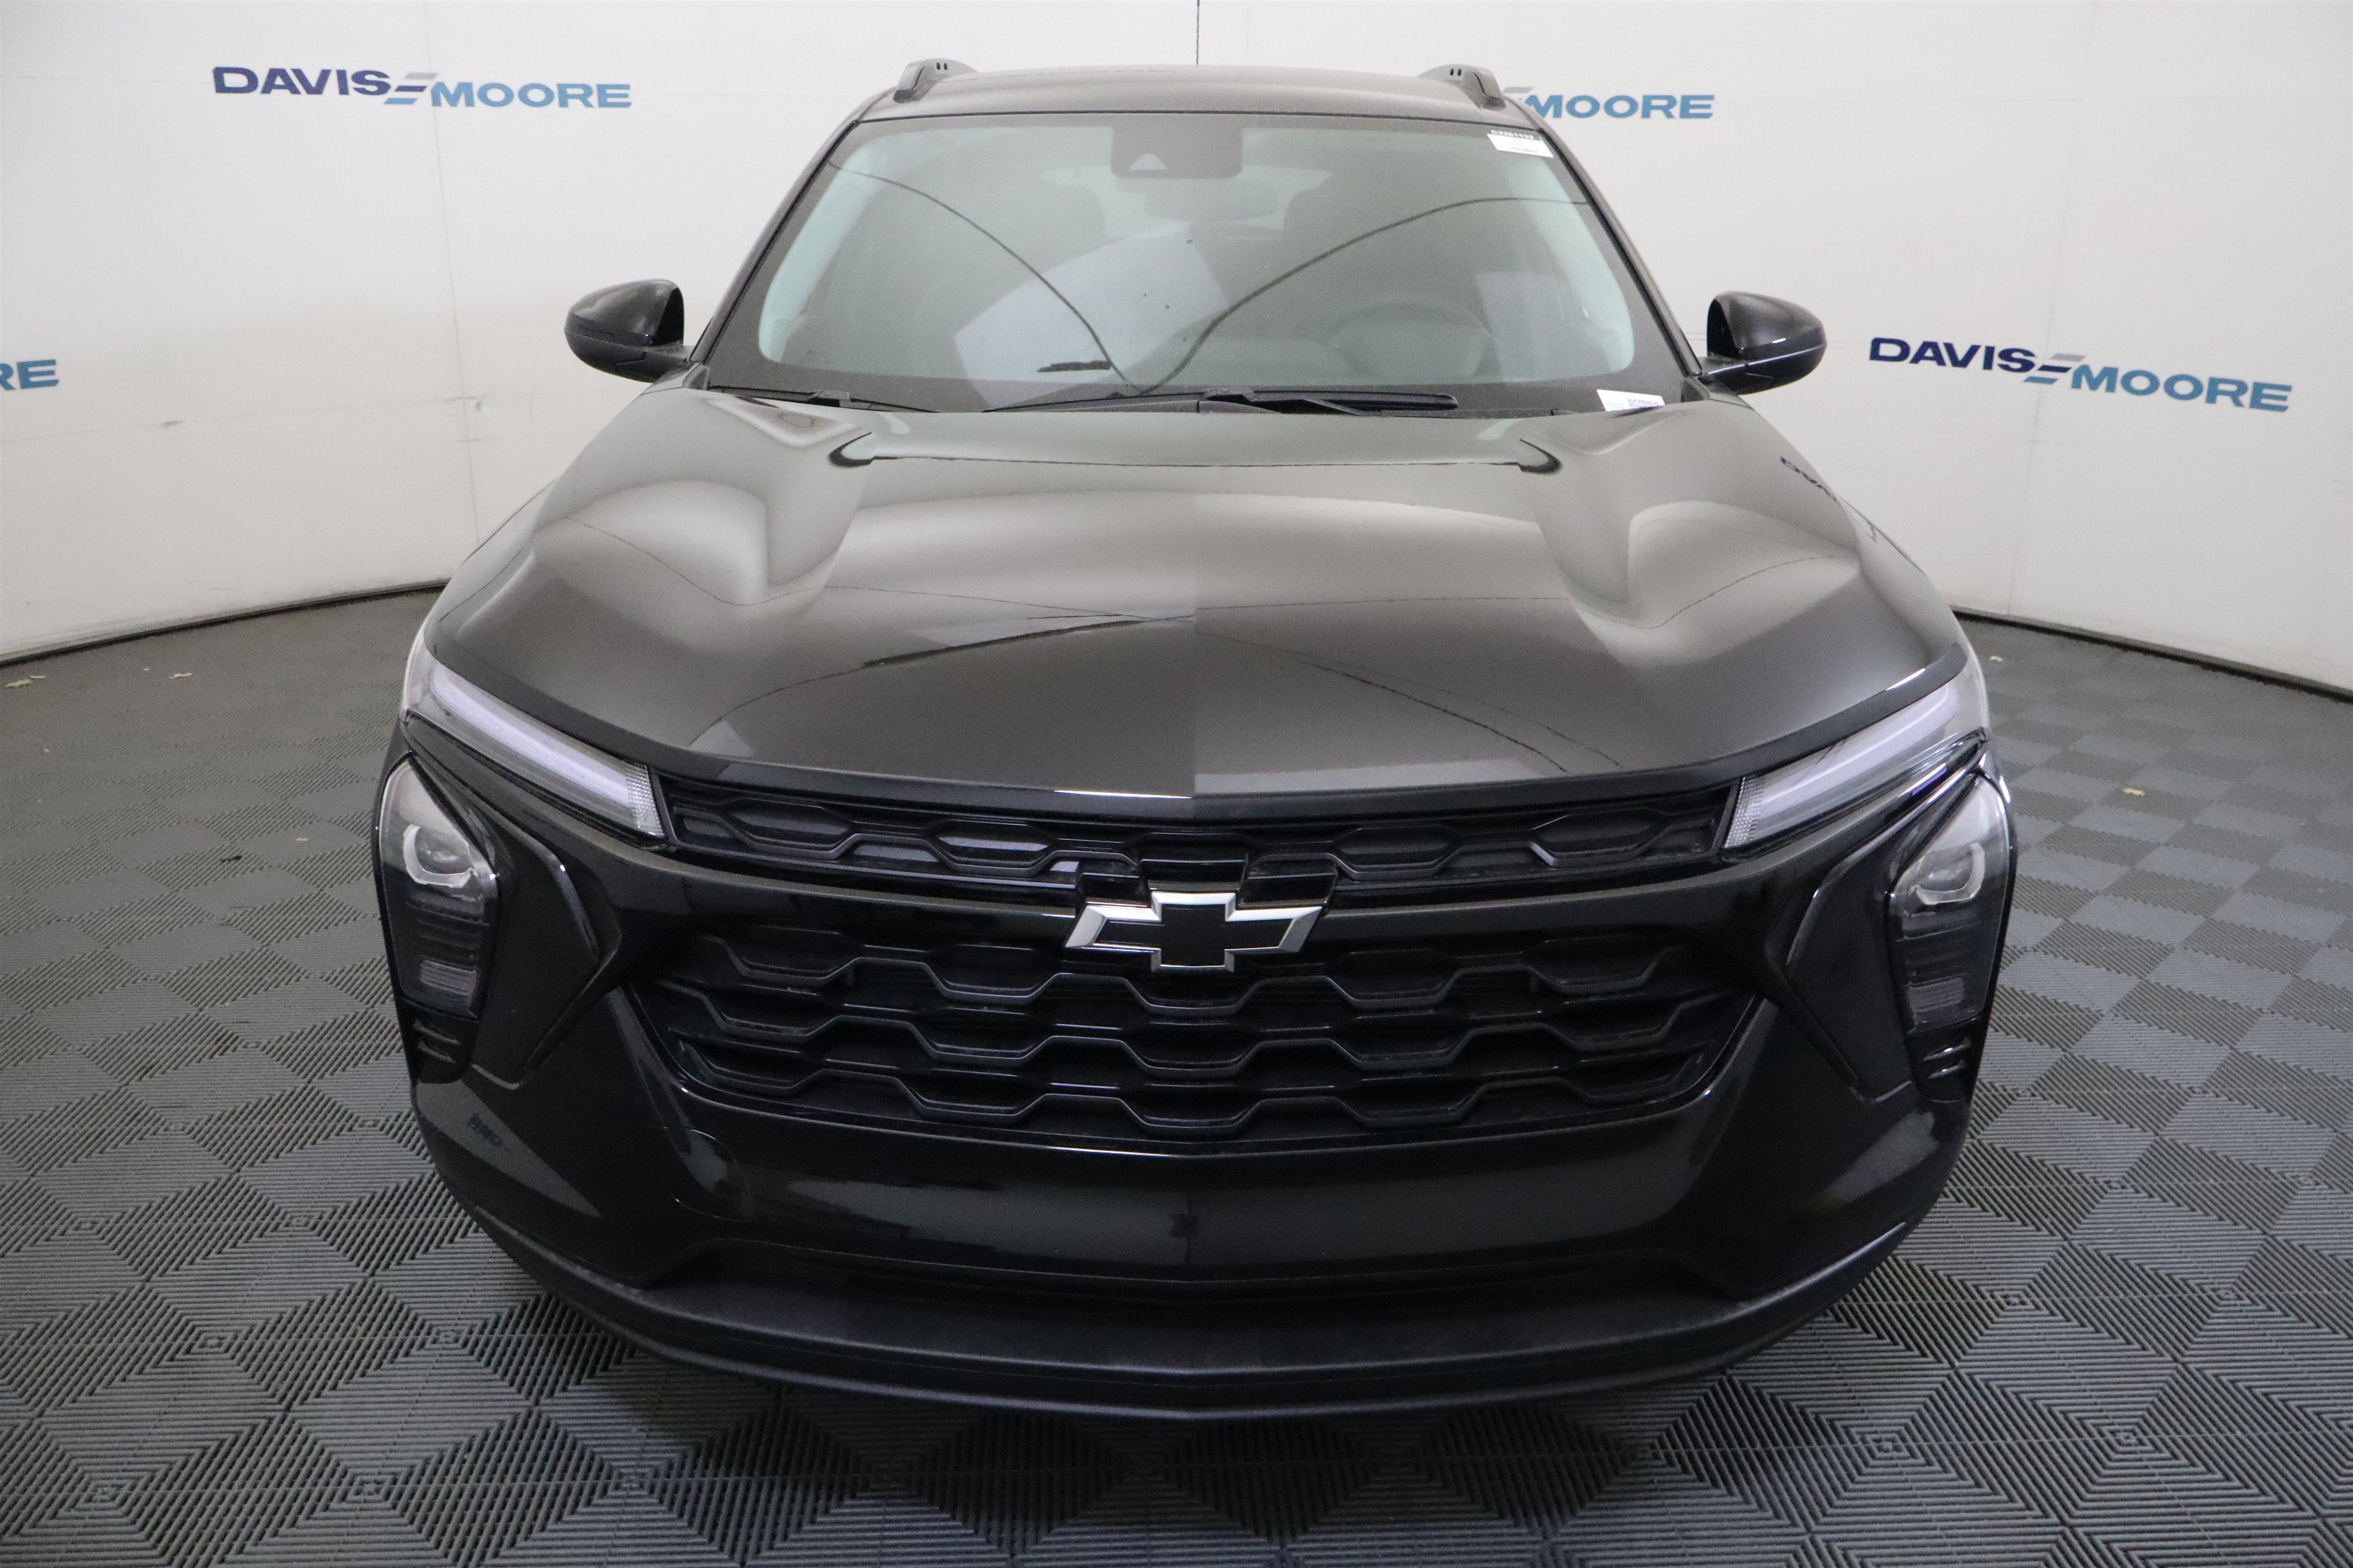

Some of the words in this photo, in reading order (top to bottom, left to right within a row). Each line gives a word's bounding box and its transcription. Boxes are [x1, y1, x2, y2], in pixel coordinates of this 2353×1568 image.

[212, 66, 391, 96] DAVIS
[430, 82, 631, 108] MOORE
[1525, 94, 1715, 119] MOORE
[1869, 337, 2036, 373] DAVIS
[2070, 364, 2292, 412] MOORE
